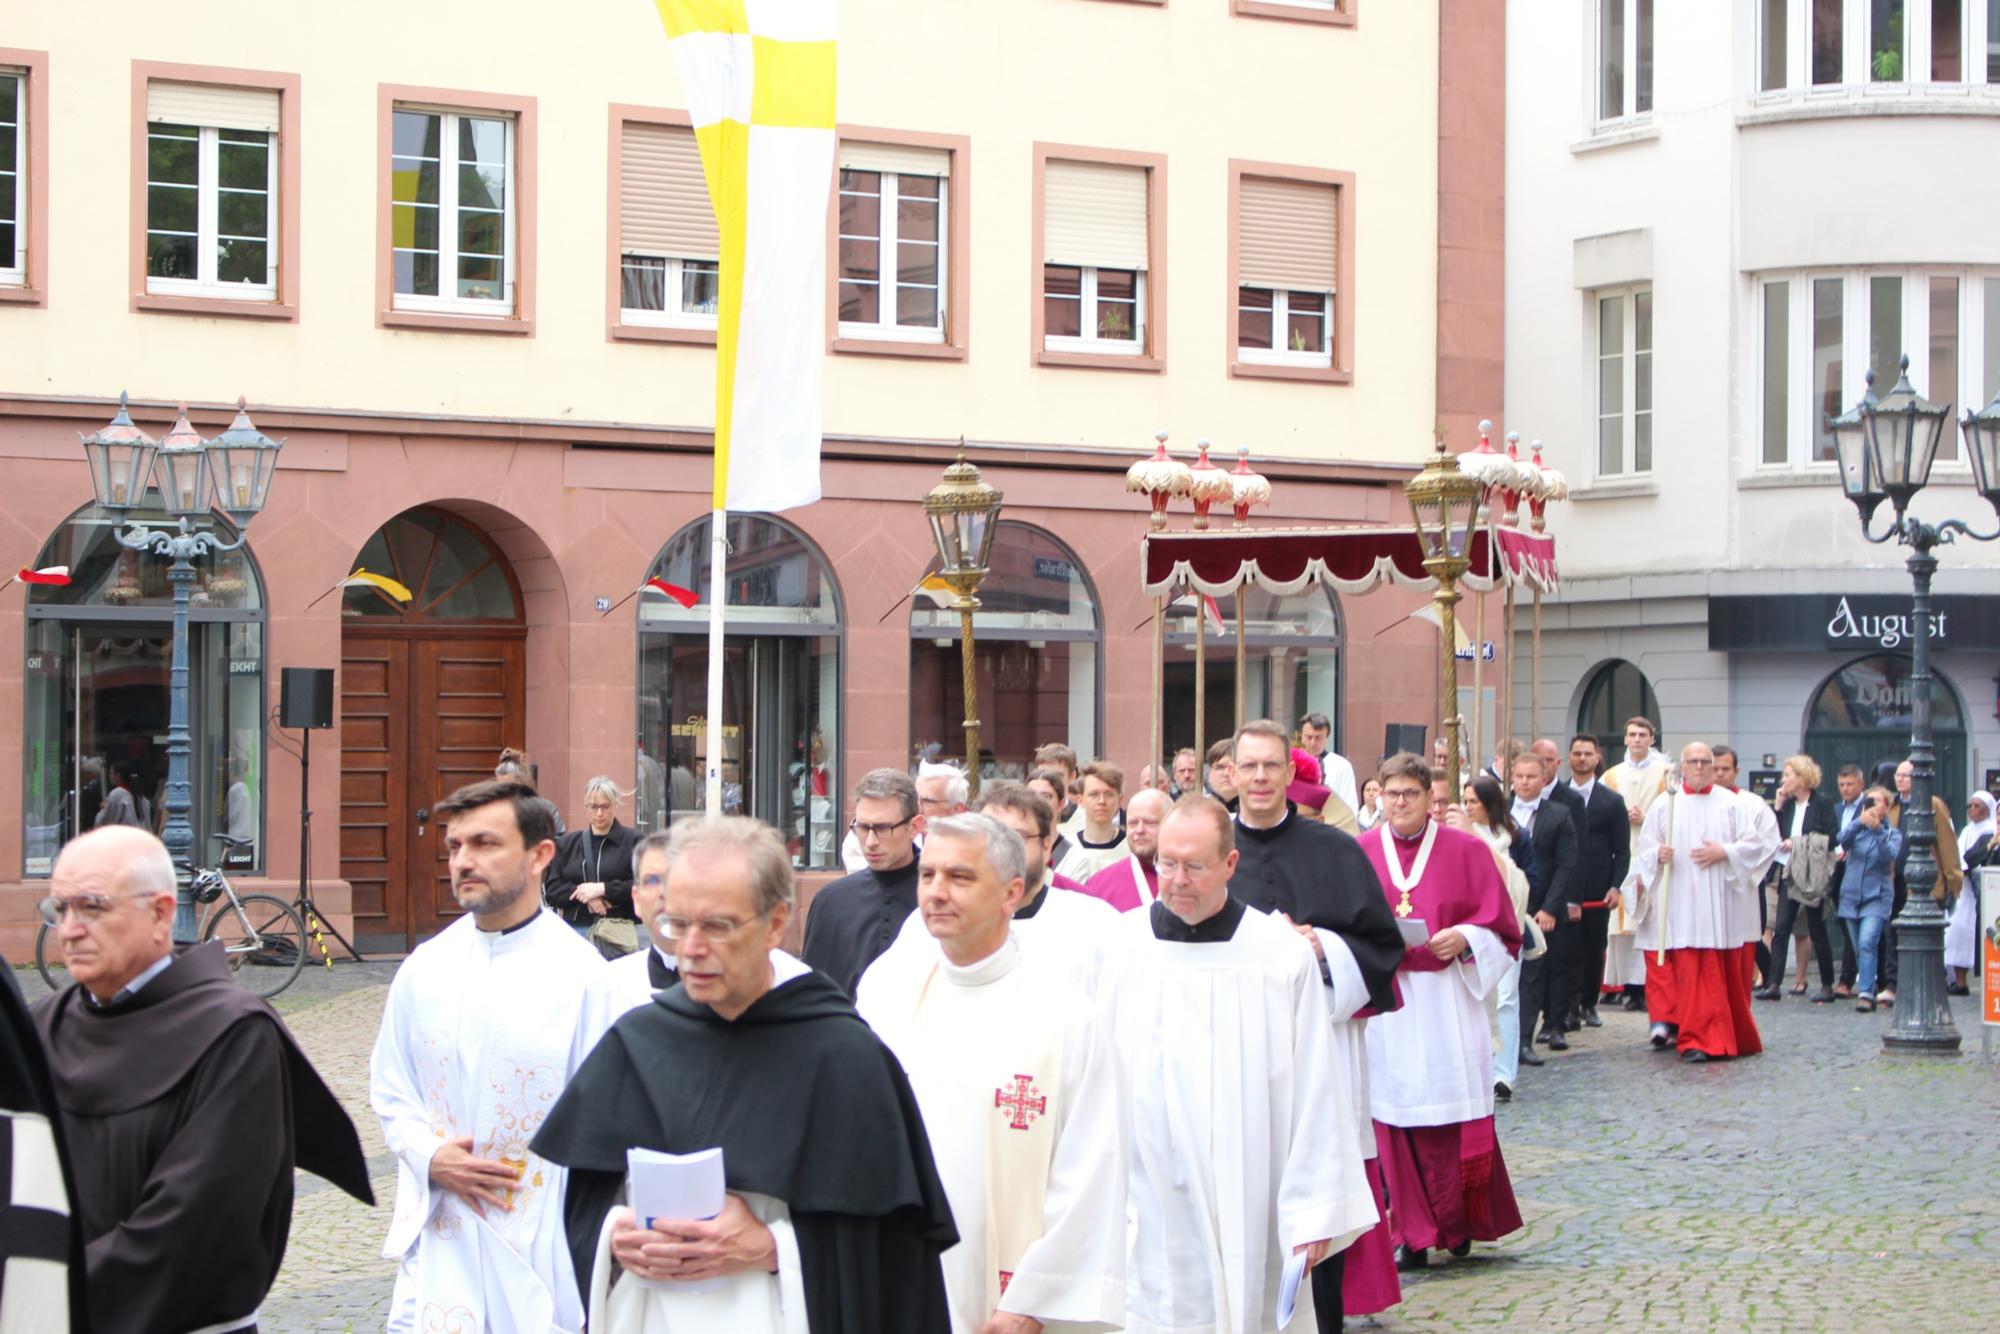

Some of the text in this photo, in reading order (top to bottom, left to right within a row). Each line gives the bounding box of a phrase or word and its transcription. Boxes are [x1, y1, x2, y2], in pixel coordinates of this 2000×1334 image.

[1827, 595, 1947, 648] August
[28, 657, 41, 668] CHT
[230, 661, 256, 672] EICHT
